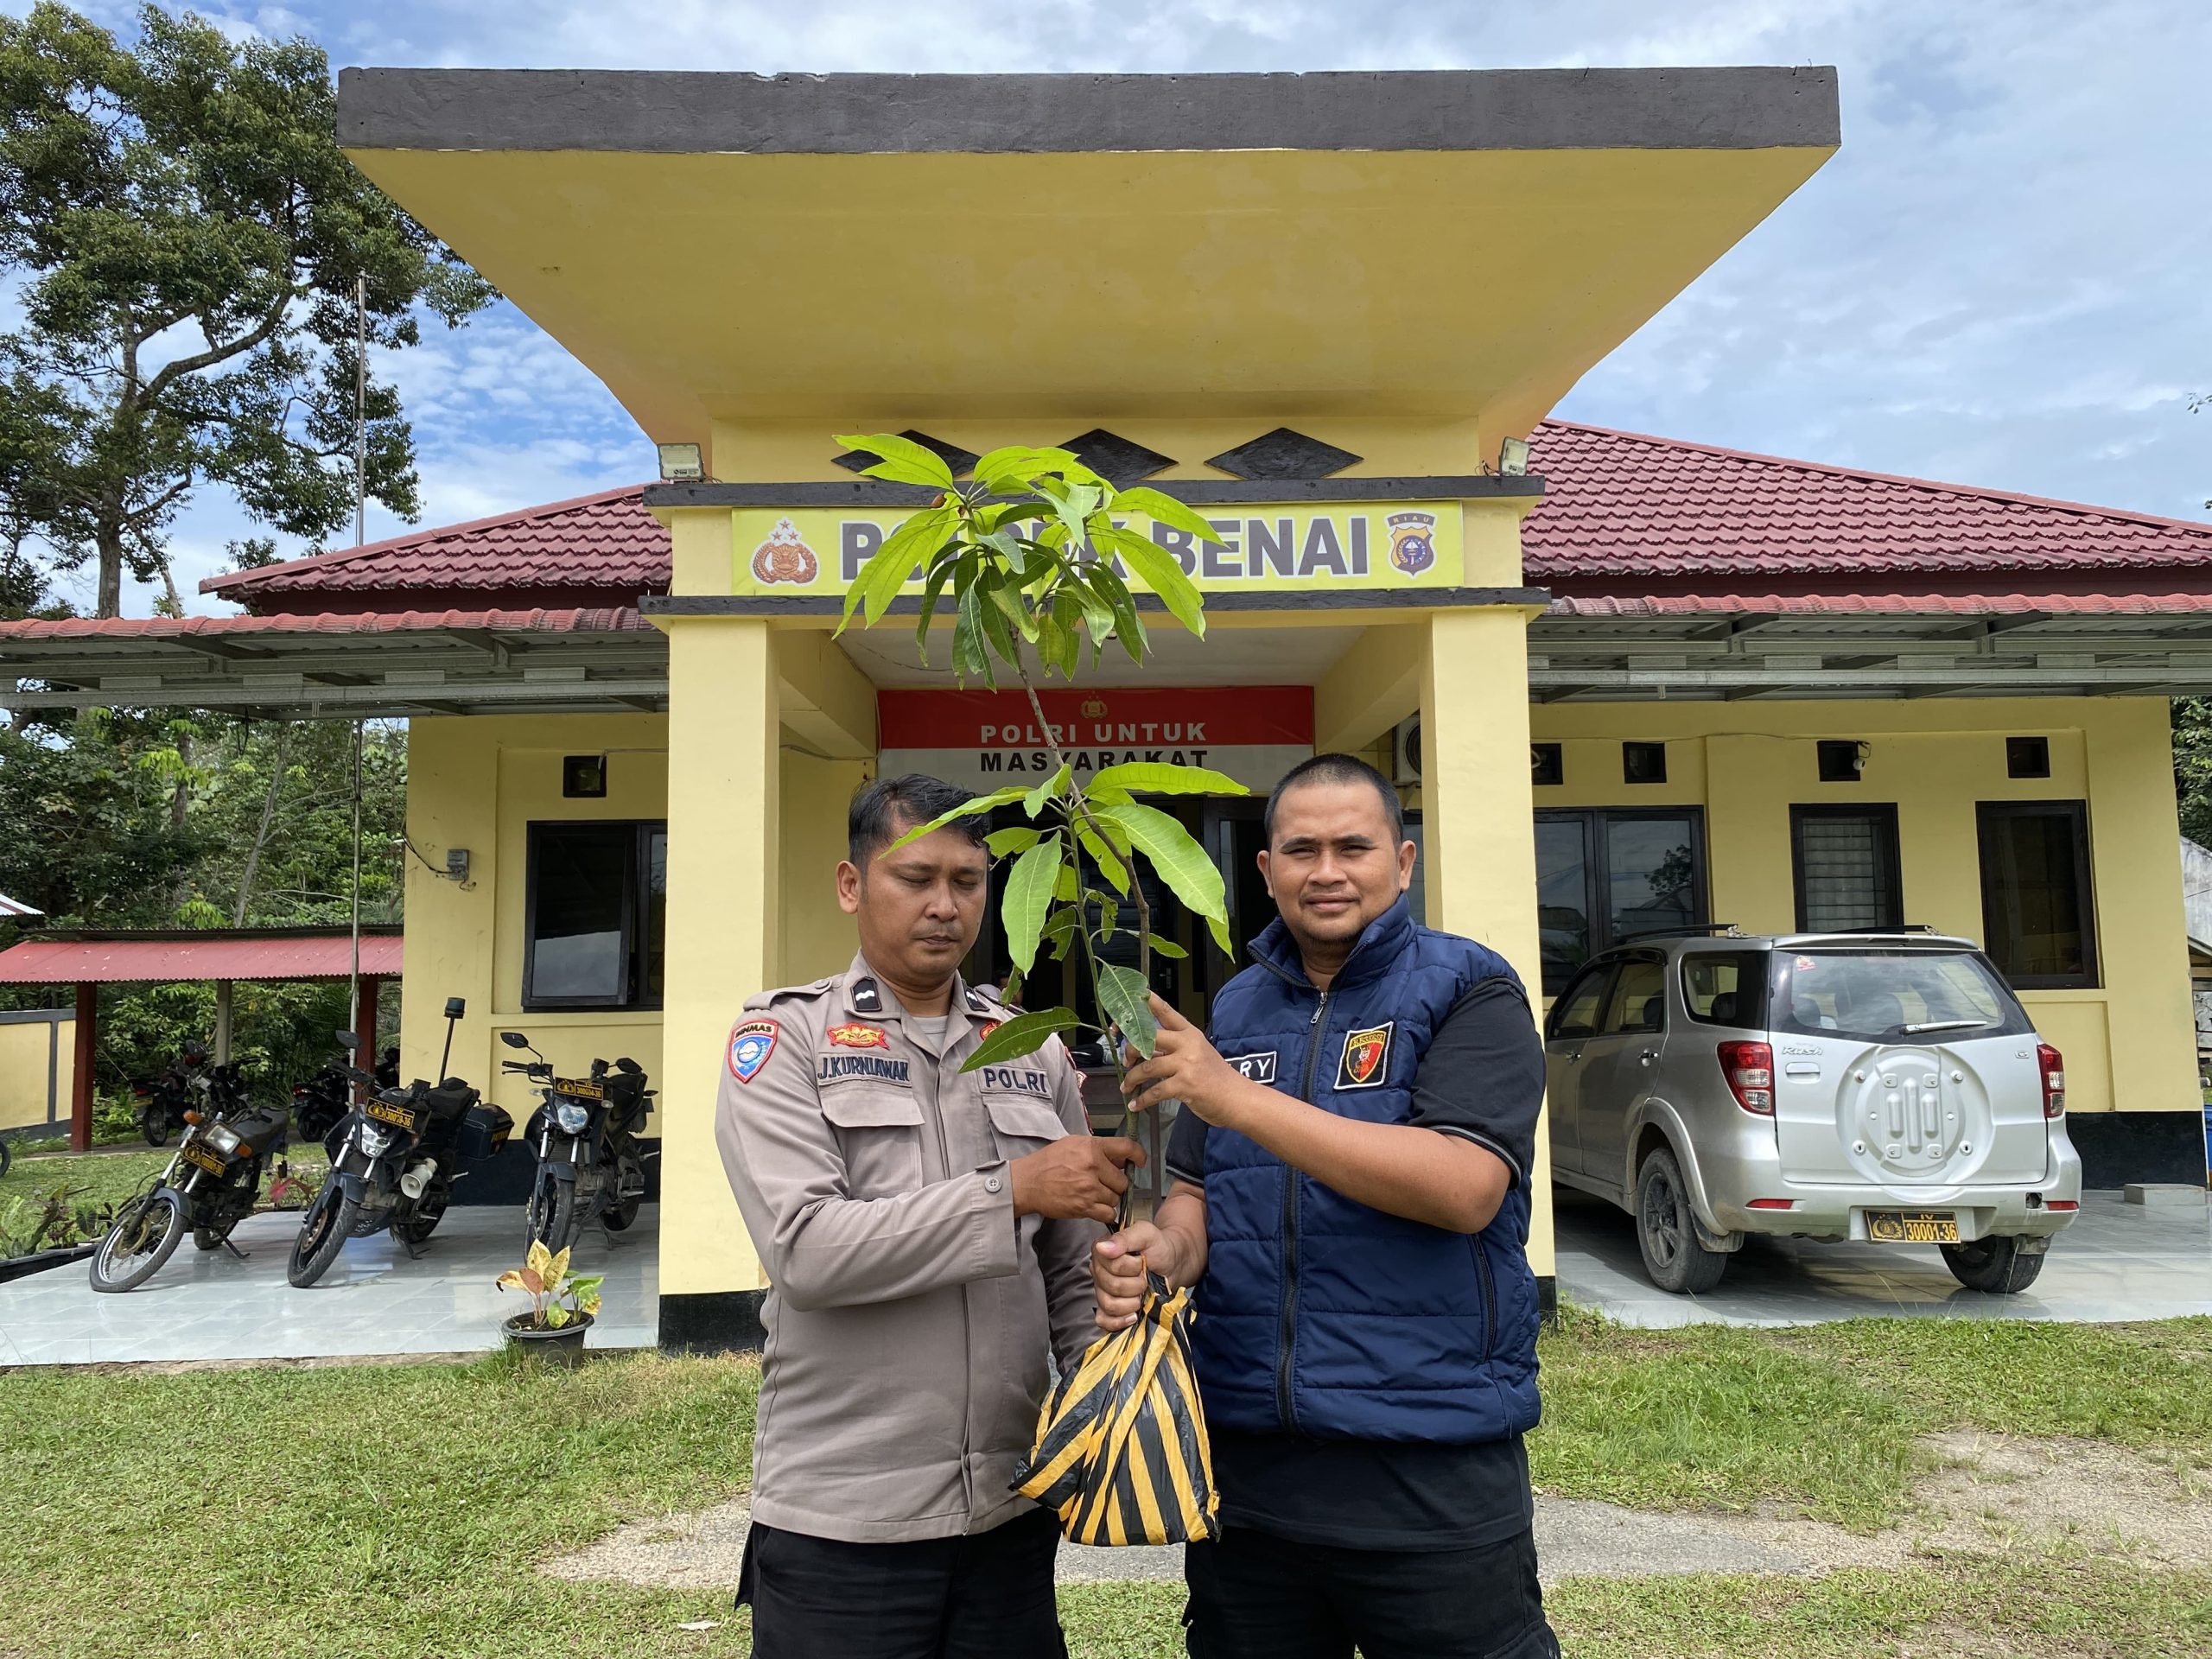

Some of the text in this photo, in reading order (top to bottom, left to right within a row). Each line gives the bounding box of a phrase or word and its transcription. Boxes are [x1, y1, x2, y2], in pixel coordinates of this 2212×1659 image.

[1153, 518, 1368, 577] BENAI
[981, 722, 1207, 743] POLRI UNTUK
[982, 1068, 1047, 1093] POLRI
[1907, 1223, 1957, 1241] 30001-36
